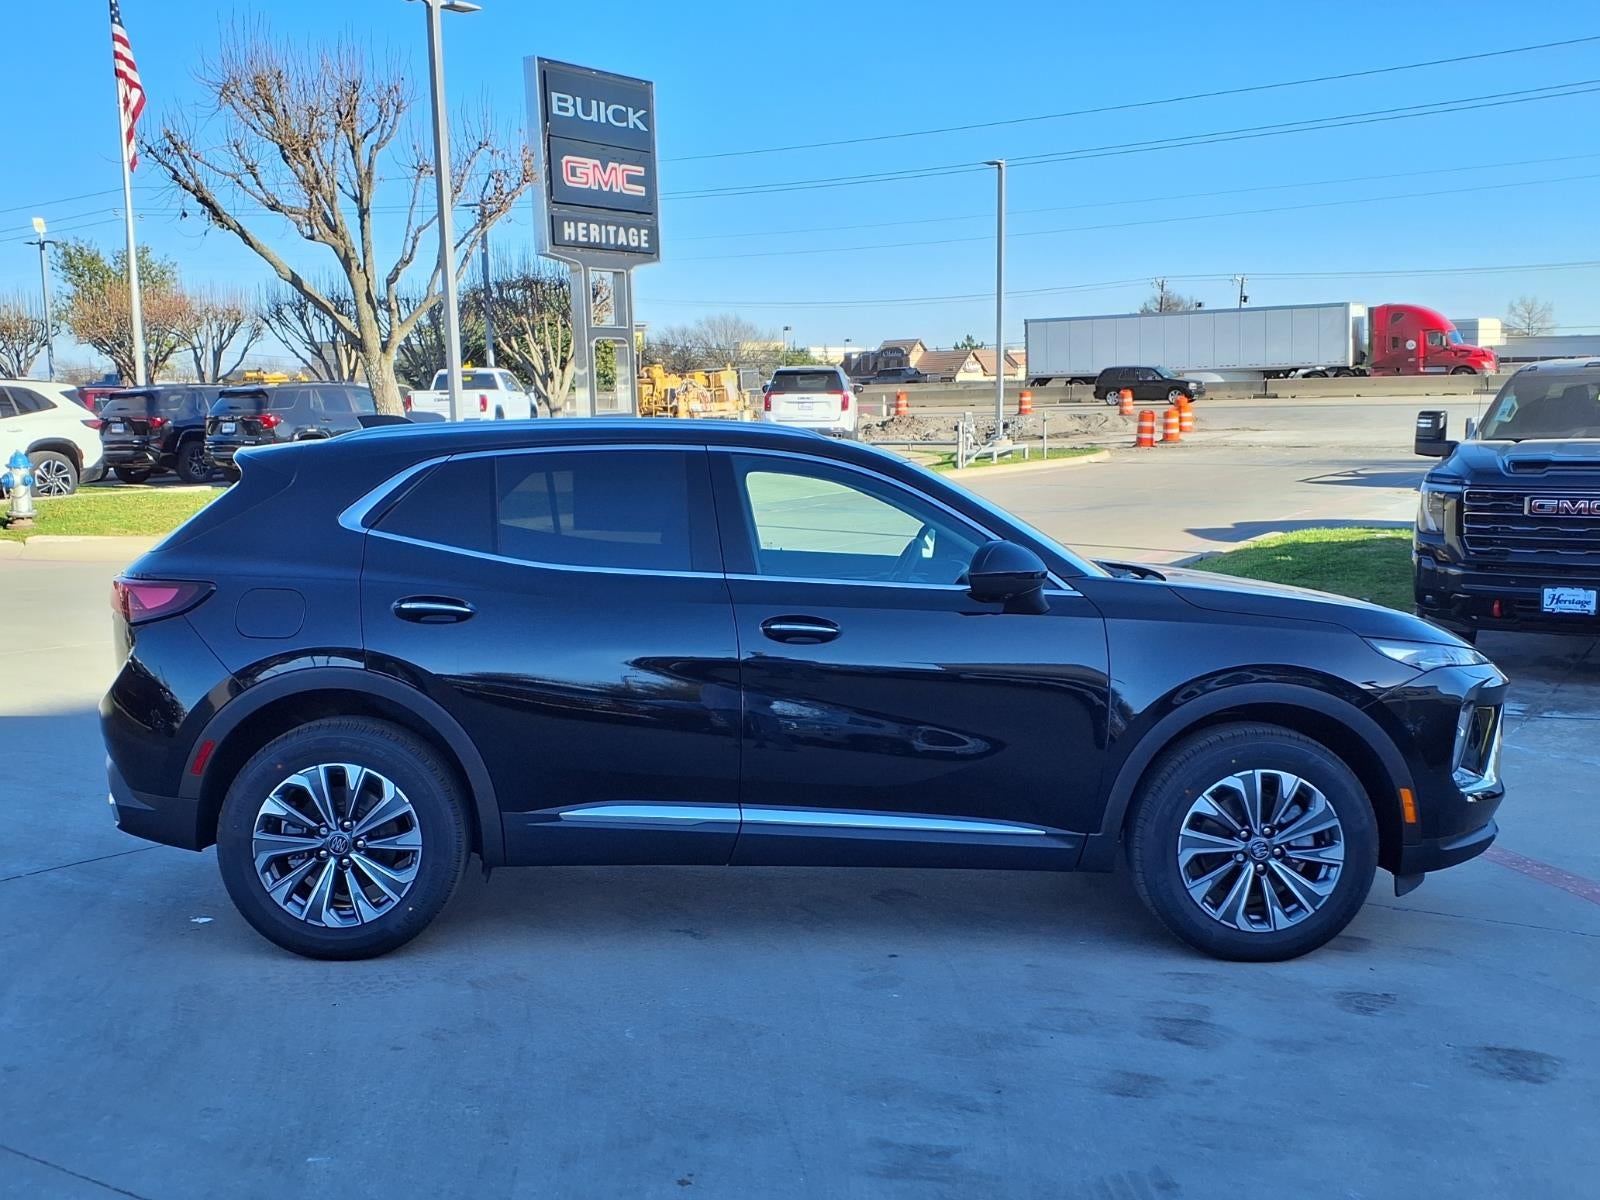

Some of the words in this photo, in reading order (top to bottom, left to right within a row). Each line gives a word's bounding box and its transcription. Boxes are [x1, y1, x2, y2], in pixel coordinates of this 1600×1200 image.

[551, 91, 648, 132] BUICK
[561, 155, 646, 196] GMC
[564, 221, 649, 248] HERITAGE
[1545, 593, 1591, 608] Heritage
